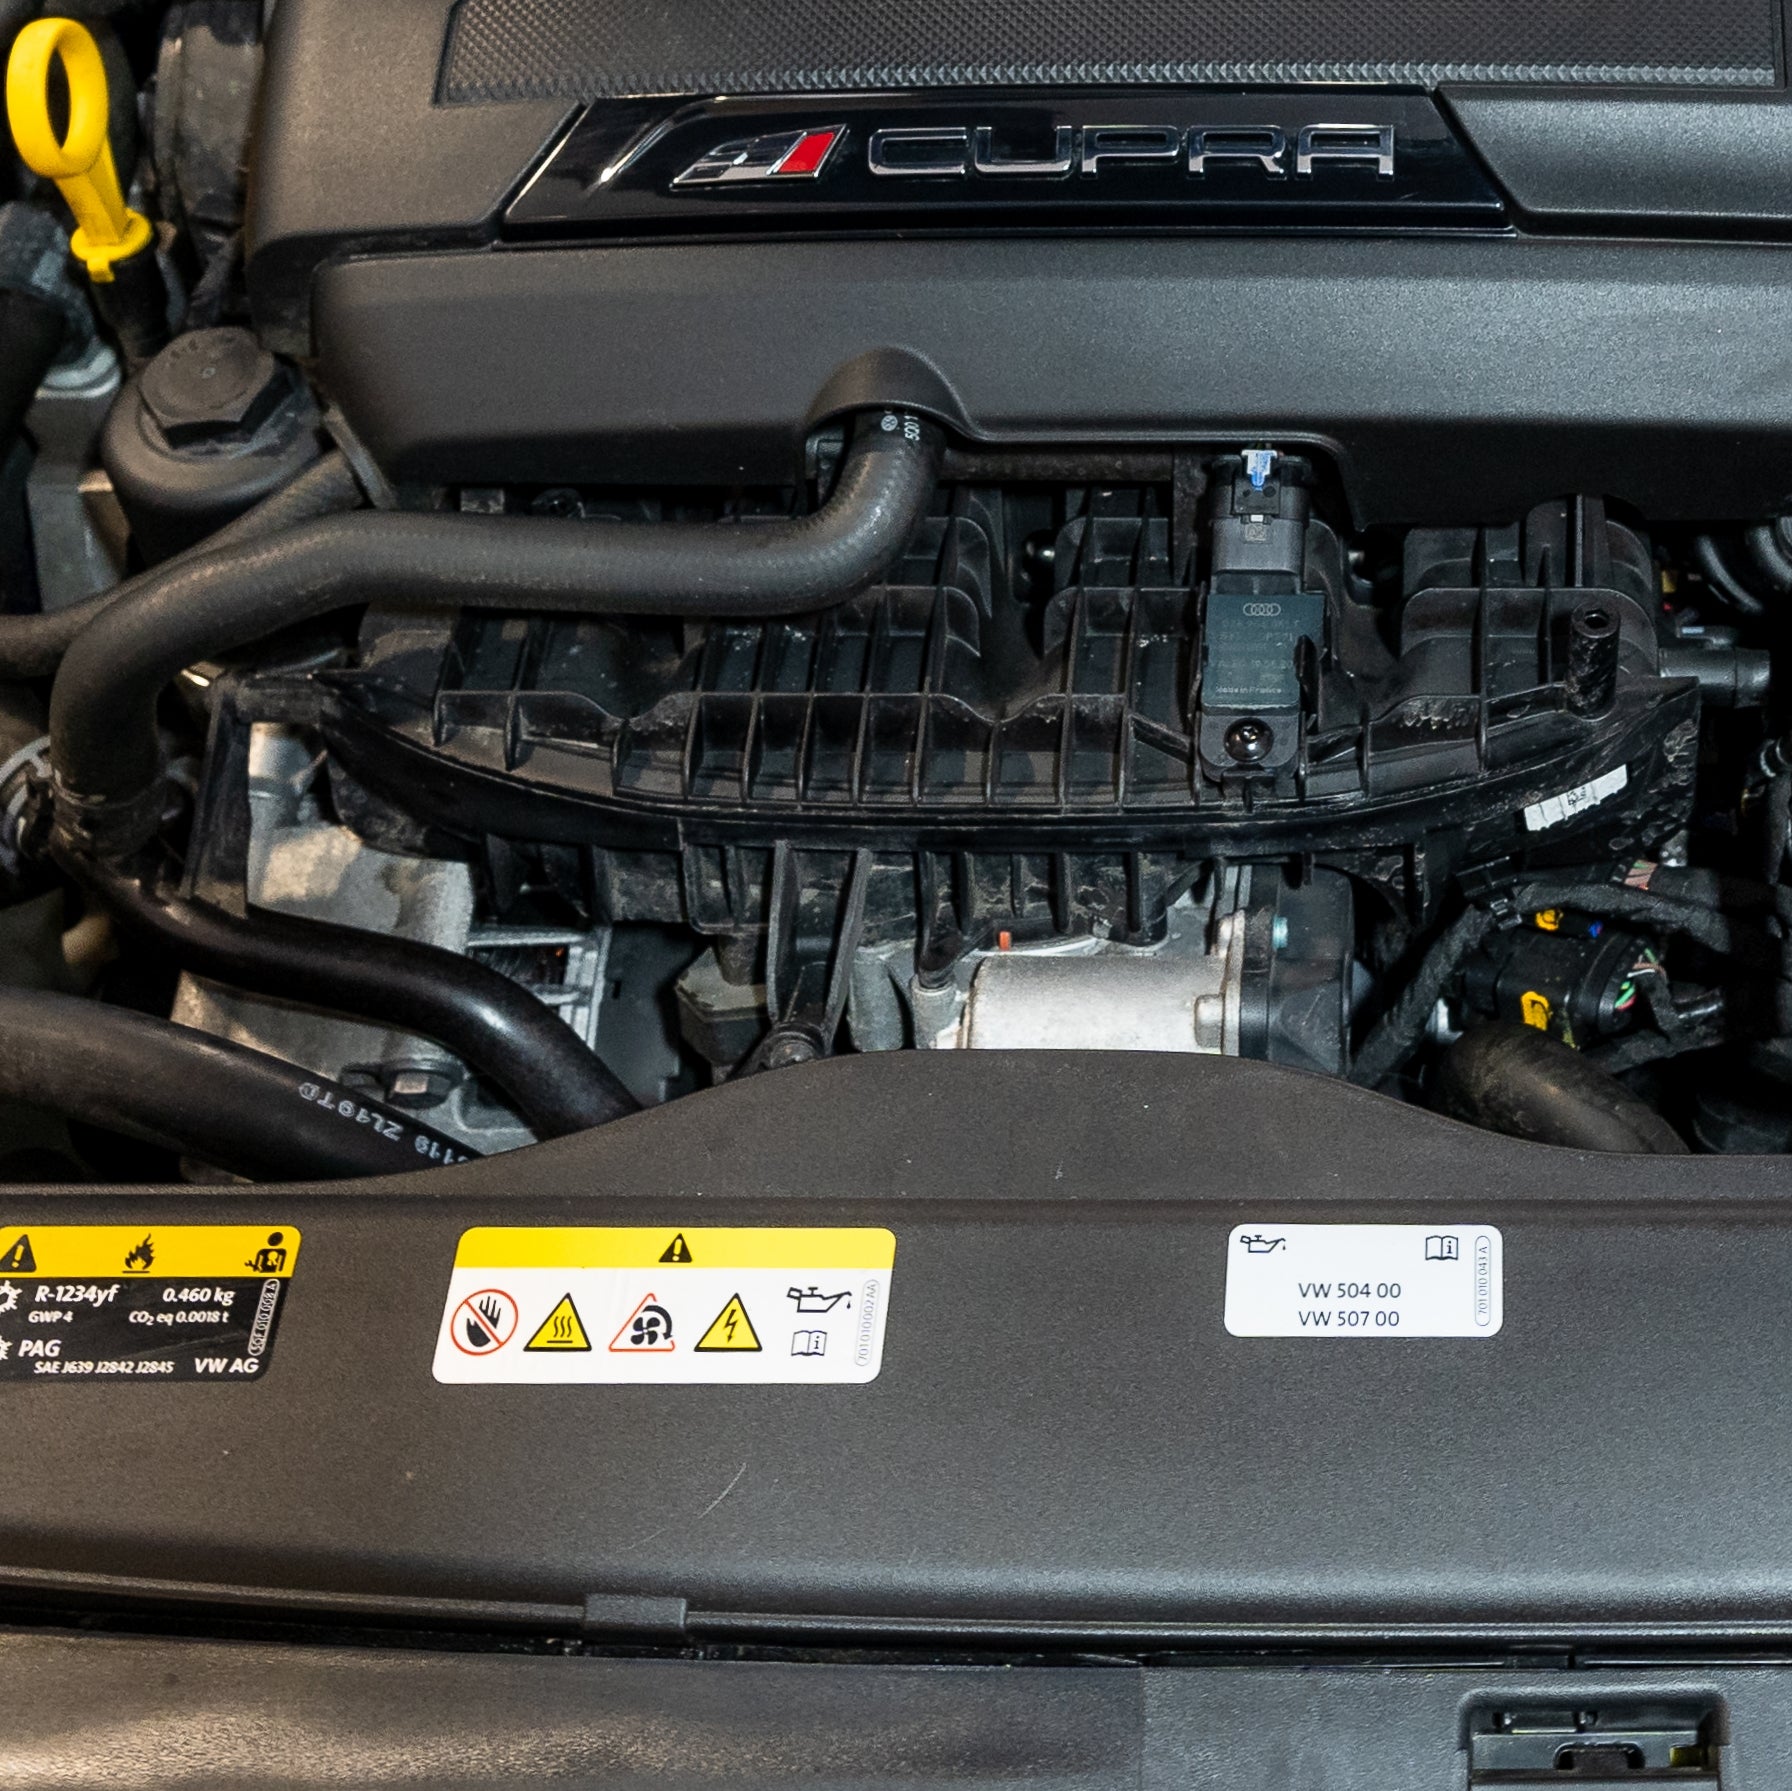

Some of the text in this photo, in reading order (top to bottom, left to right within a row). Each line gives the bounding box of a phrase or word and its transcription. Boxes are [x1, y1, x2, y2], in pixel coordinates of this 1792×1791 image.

[868, 124, 1395, 179] CUPRA
[34, 1284, 235, 1307] R-1234yf 0.460 kg
[1298, 1283, 1402, 1298] VW 504 00
[28, 1311, 74, 1323] GWP 4
[156, 1312, 175, 1326] eq
[222, 1311, 229, 1323] t
[1298, 1310, 1401, 1326] VW 507 00
[18, 1339, 62, 1357] PAG
[33, 1361, 60, 1373] SAE
[95, 1361, 134, 1374] J2842
[195, 1358, 260, 1373] VW AG
